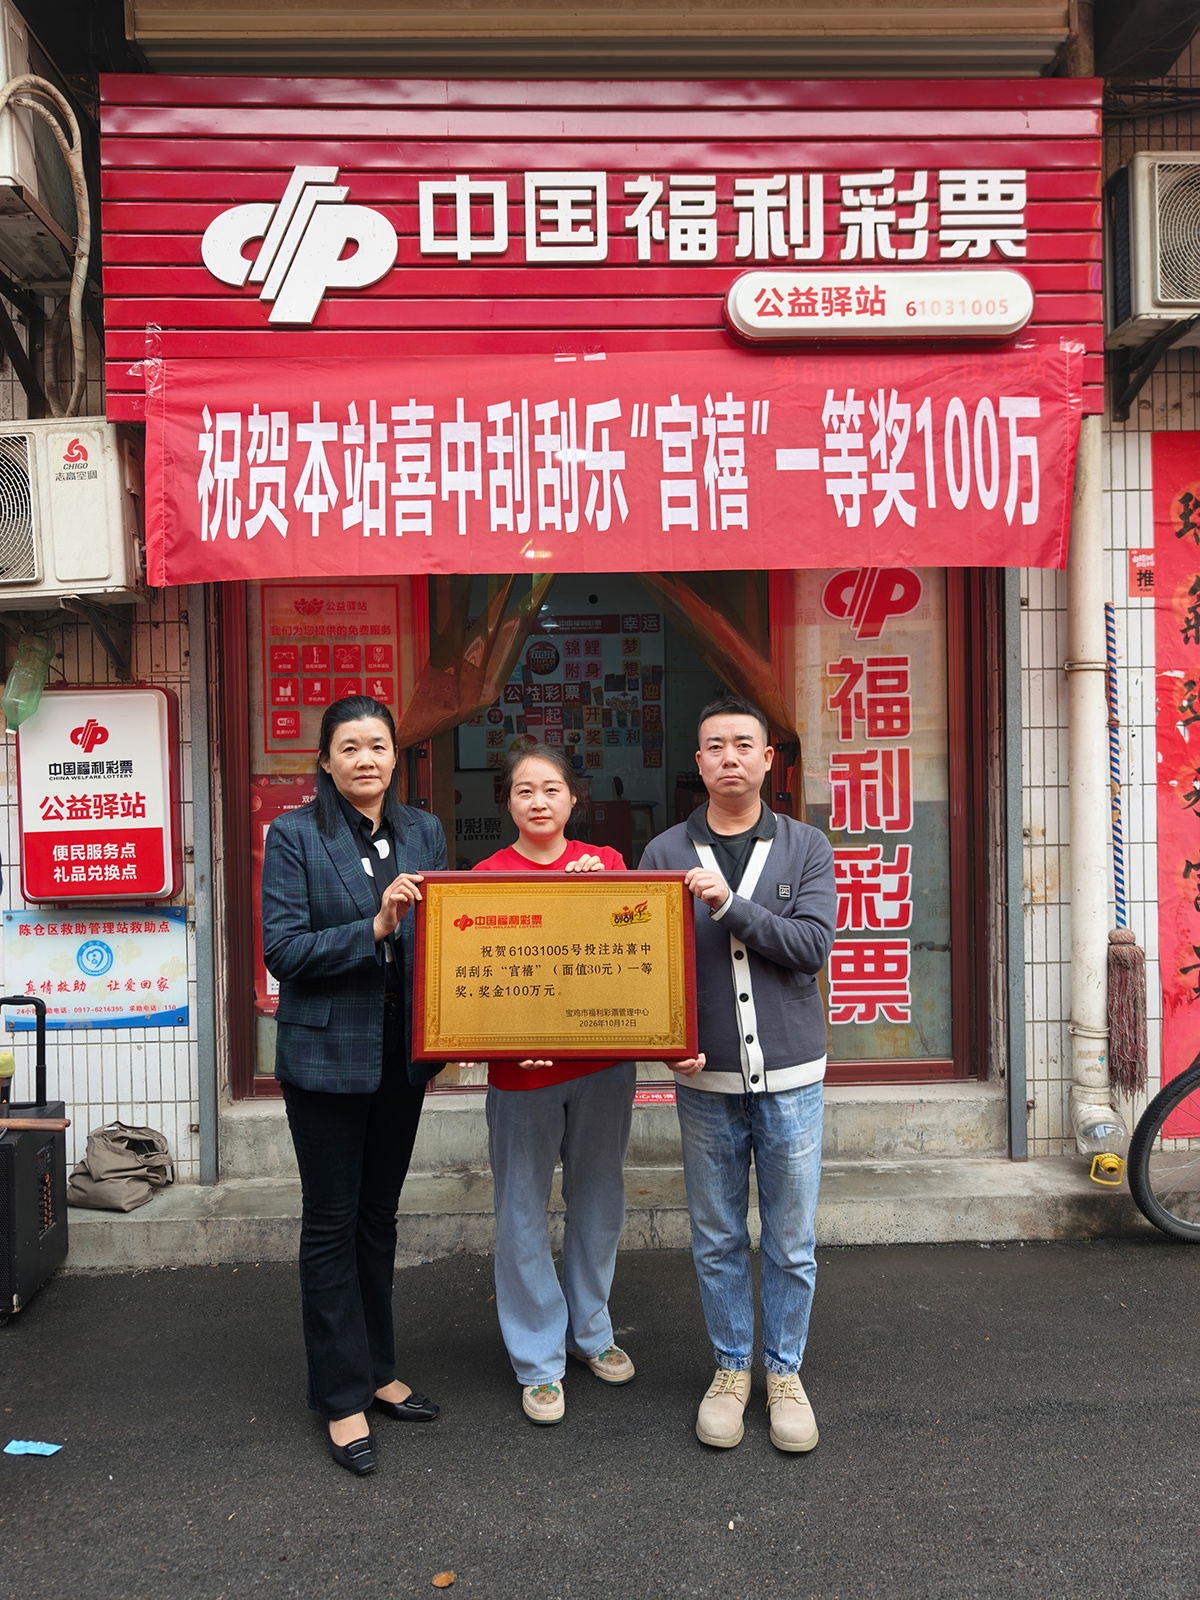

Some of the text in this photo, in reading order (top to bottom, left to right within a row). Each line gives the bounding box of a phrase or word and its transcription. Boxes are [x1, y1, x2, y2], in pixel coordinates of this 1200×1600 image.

[418, 168, 1027, 263] 中国福利彩票
[754, 285, 1009, 318] 公益驿站 61031005
[63, 462, 88, 471] CHIGO
[55, 470, 98, 481] 志高空调
[1137, 569, 1154, 587] 推
[326, 601, 367, 611] 公益驿站
[270, 625, 391, 636] 我们为您提供的免费服务
[623, 615, 659, 632] 幸运
[565, 640, 600, 656] 锦鲤
[623, 638, 639, 677] 梦想
[565, 662, 600, 678] 附身
[506, 684, 581, 701] 公益彩票
[526, 708, 561, 723] 一起
[585, 707, 601, 767] 开奖啦
[606, 729, 640, 744] 吉利
[49, 760, 133, 776] 中国福利彩票
[39, 791, 146, 821] 公益驿站
[828, 655, 913, 1024] 福利彩票
[52, 842, 136, 862] 便民服务点
[53, 863, 137, 883] 礼品兑换点
[474, 914, 542, 925] 中国福利彩票
[18, 920, 171, 937] 陈仓区救助管理站救助点
[480, 943, 652, 958] 祝贺61031005号投注站喜中
[24, 977, 170, 996] 真情救助 让爱回家
[565, 1008, 650, 1017] 宝鸡市福利彩票管理中心
[579, 1019, 637, 1027] 2026年10月12日
